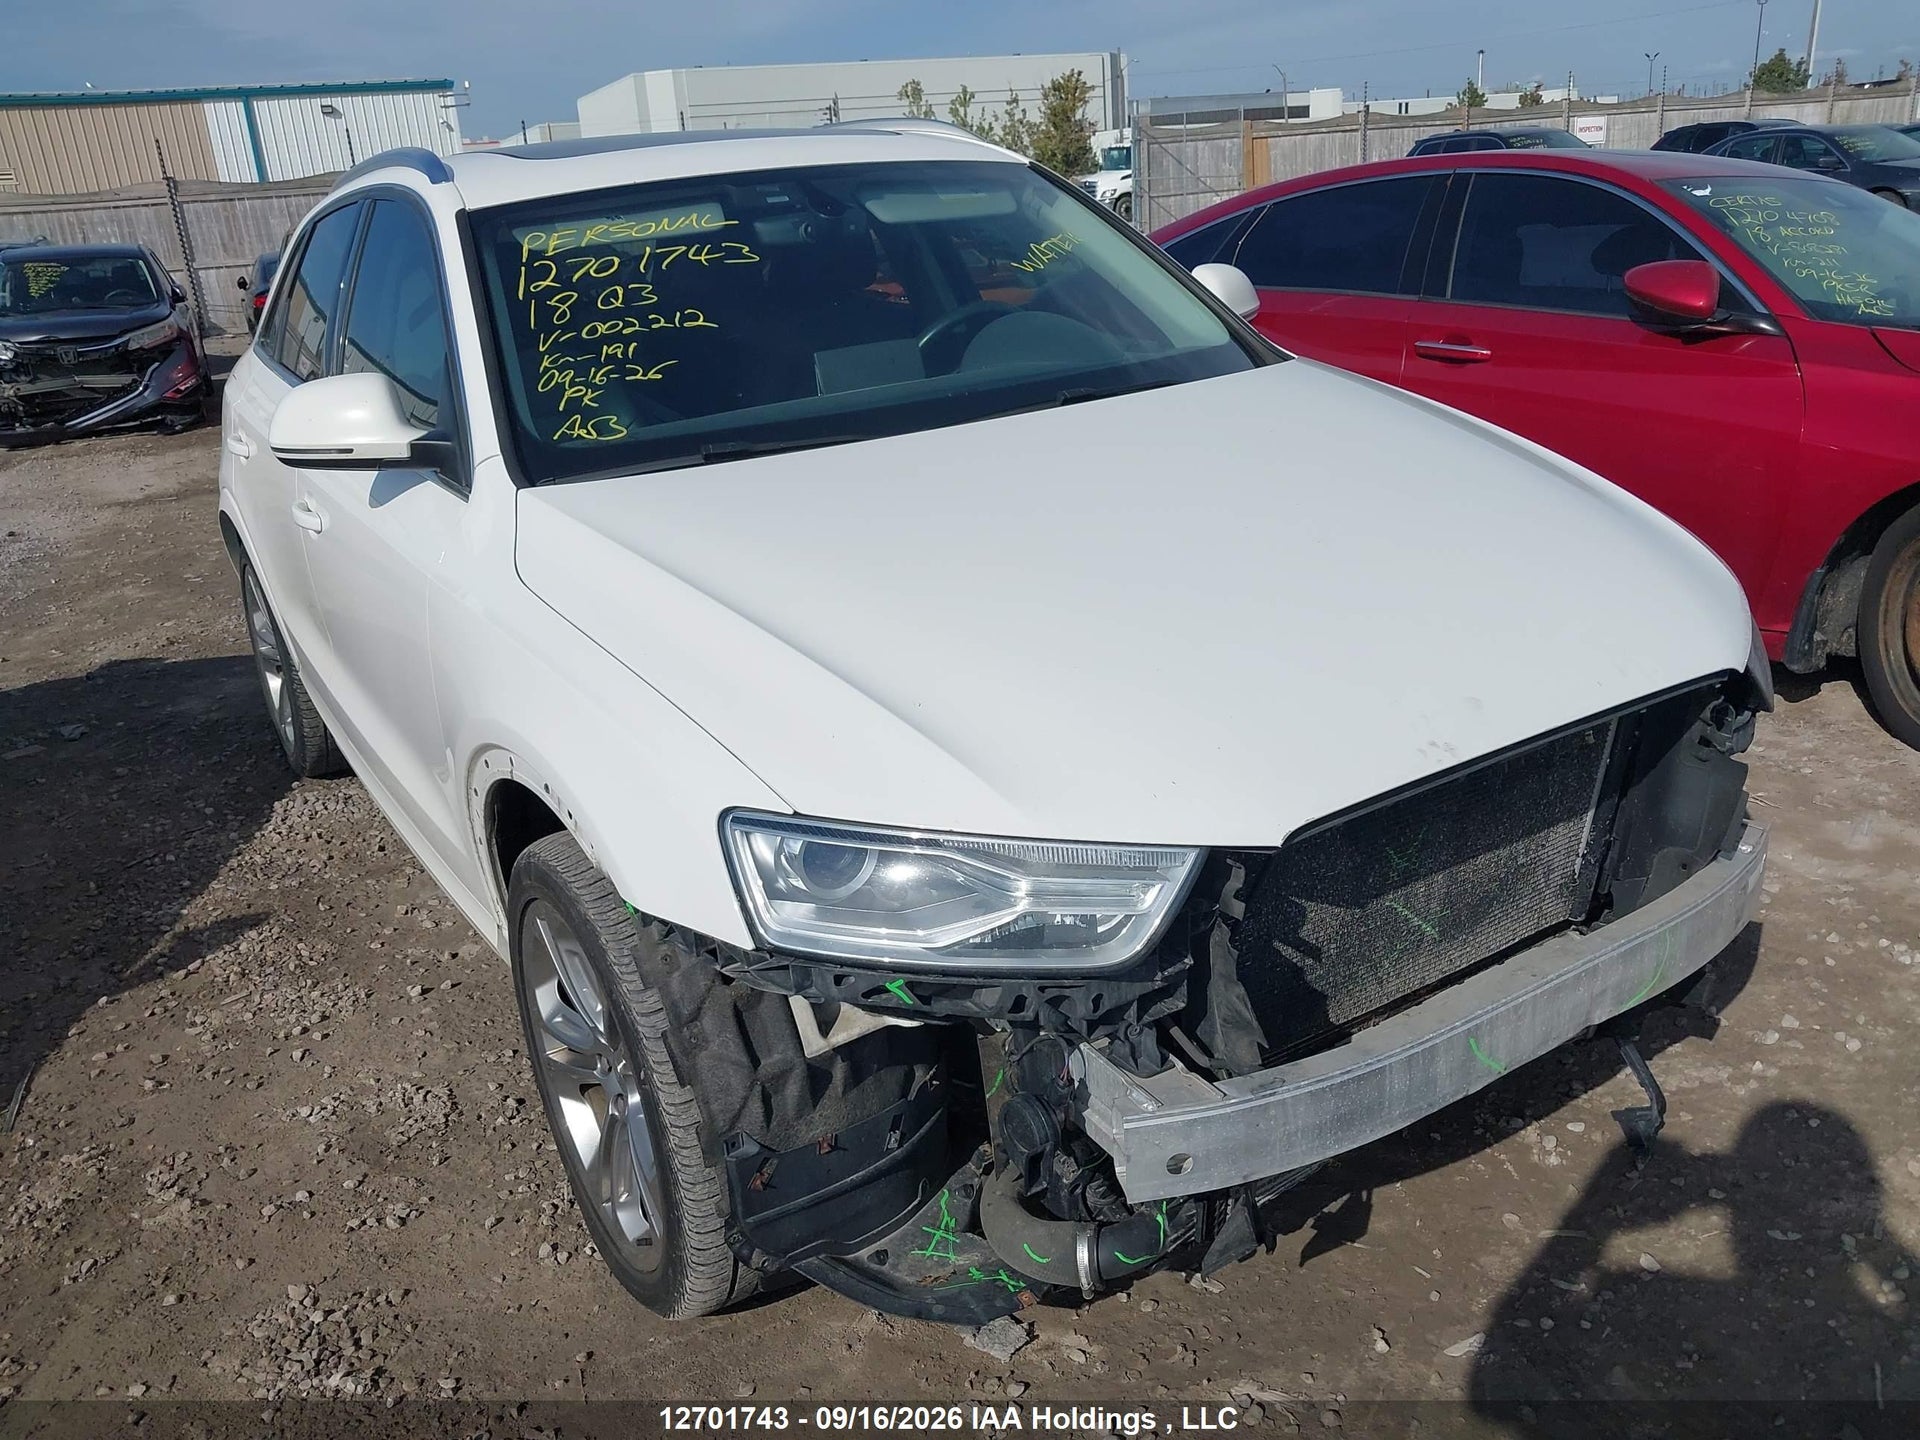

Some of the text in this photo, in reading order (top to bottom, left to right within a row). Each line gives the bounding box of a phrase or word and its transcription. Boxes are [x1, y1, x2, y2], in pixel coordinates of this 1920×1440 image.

[1578, 125, 1603, 134] INSPECTION
[522, 212, 739, 263] PERSONAL
[1780, 226, 1834, 236] ACCORD
[531, 284, 658, 330] 18 Q3
[539, 309, 719, 352] V-002212
[538, 360, 679, 392] 09-16-26
[559, 386, 605, 412] PK
